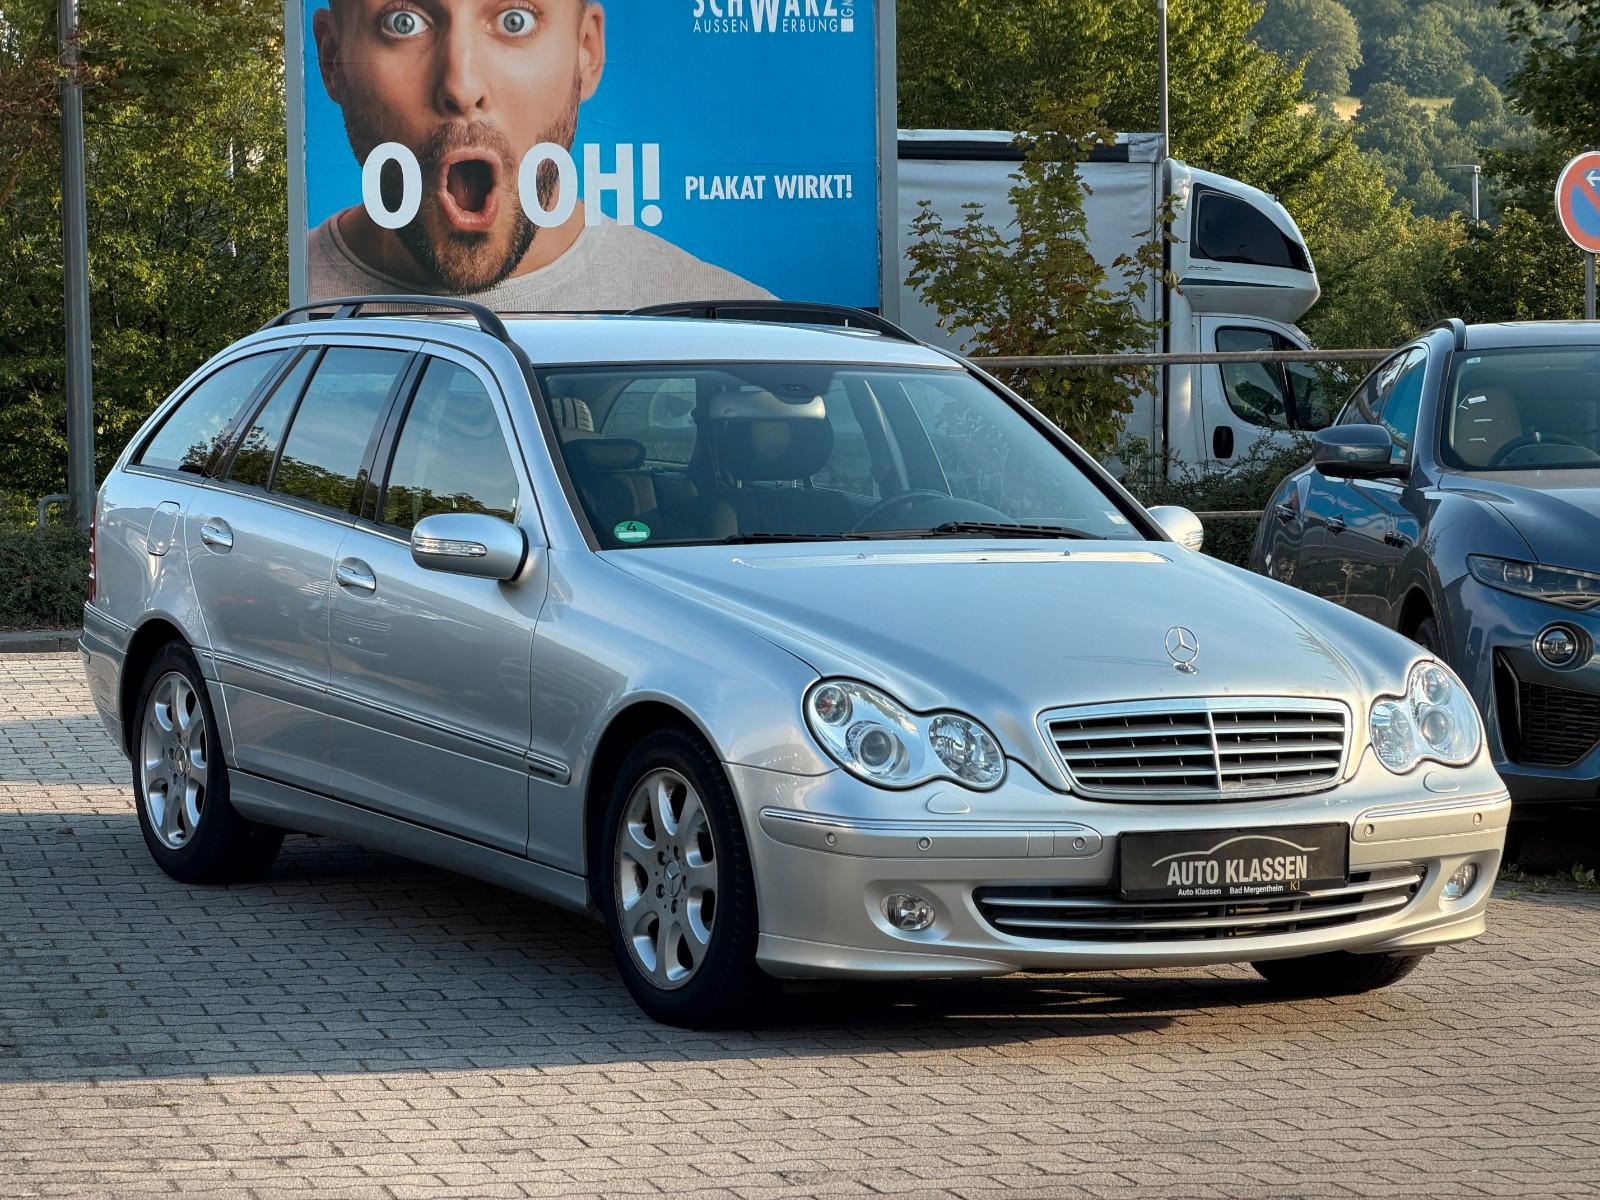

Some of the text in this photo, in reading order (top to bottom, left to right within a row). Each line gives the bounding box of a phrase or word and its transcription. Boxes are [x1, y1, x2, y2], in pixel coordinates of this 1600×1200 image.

[685, 174, 854, 201] PLAKAT WIRKT!
[627, 521, 636, 531] 4
[1166, 856, 1307, 886] AUTO KLASSEN
[1178, 883, 1284, 896] Auto Klassen Bad Mergentheim
